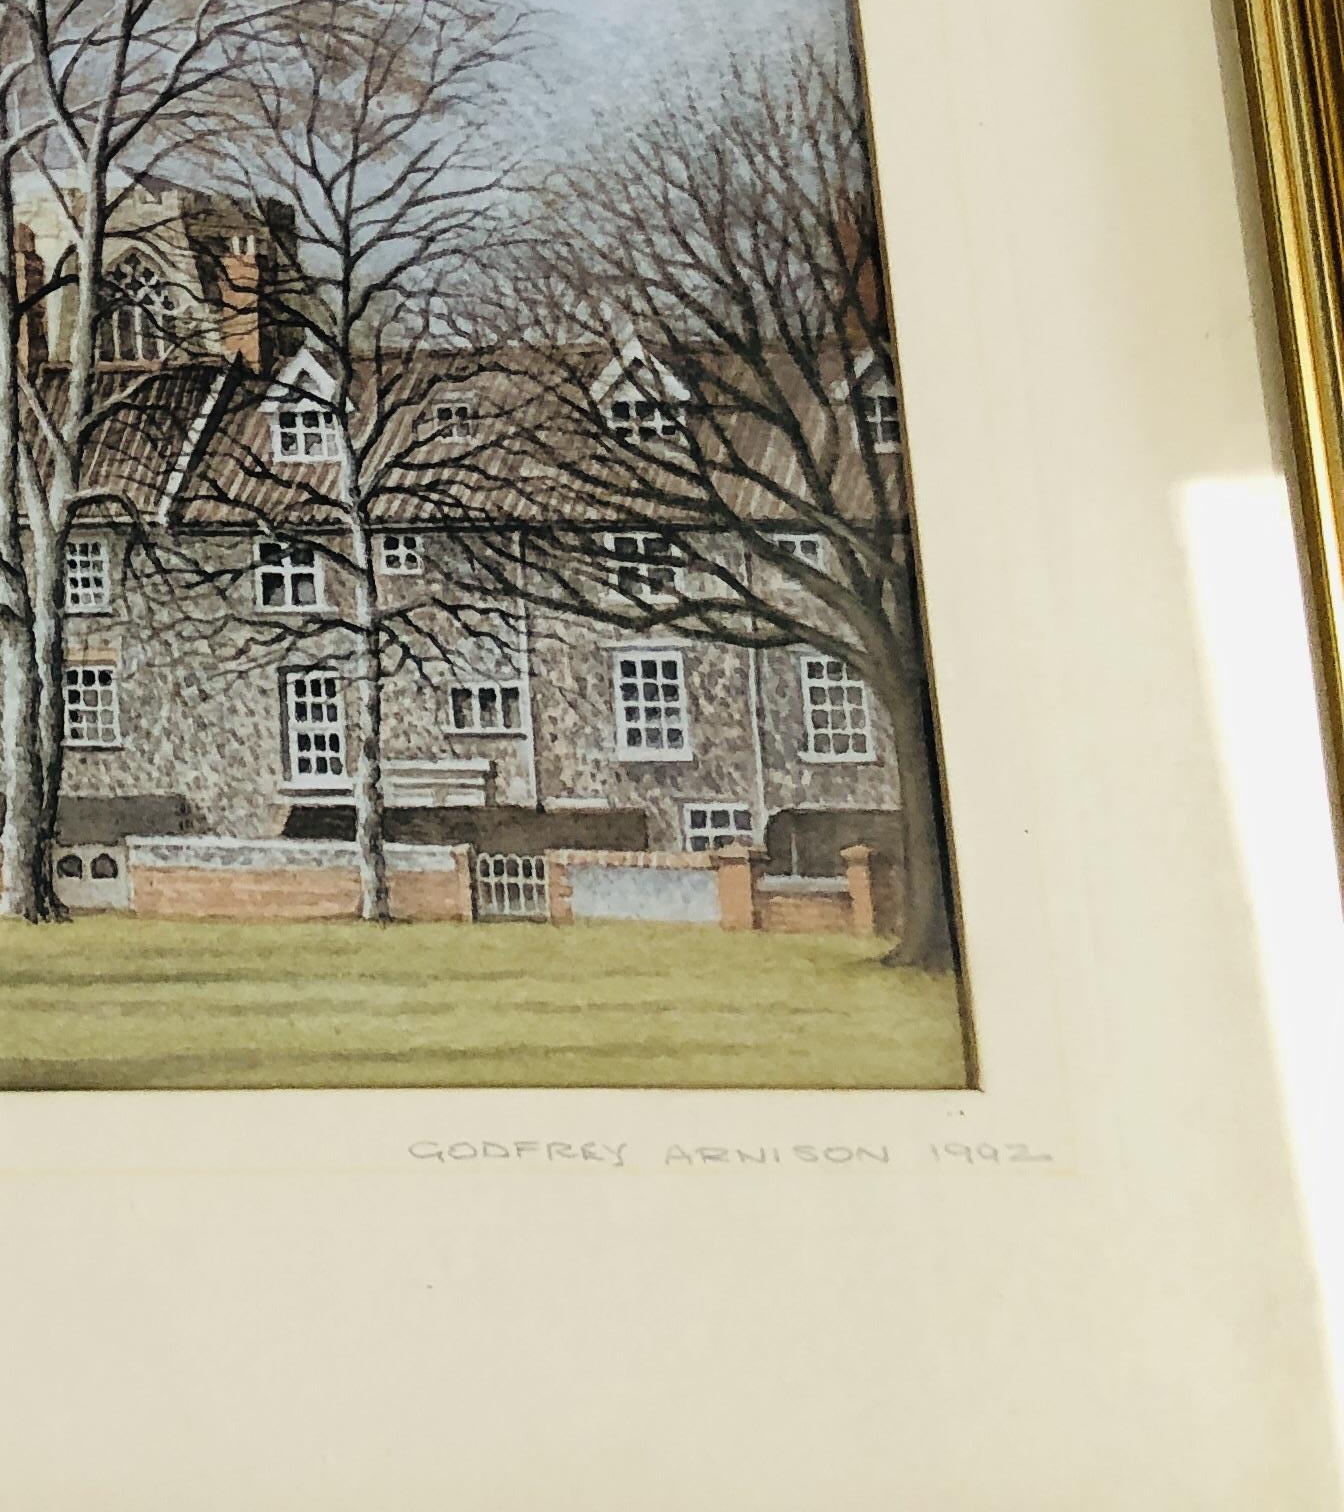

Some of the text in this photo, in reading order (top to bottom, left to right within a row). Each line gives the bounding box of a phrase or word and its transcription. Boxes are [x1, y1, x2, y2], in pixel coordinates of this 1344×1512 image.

[407, 1139, 1055, 1168] GODFREY ARNISON 1992
